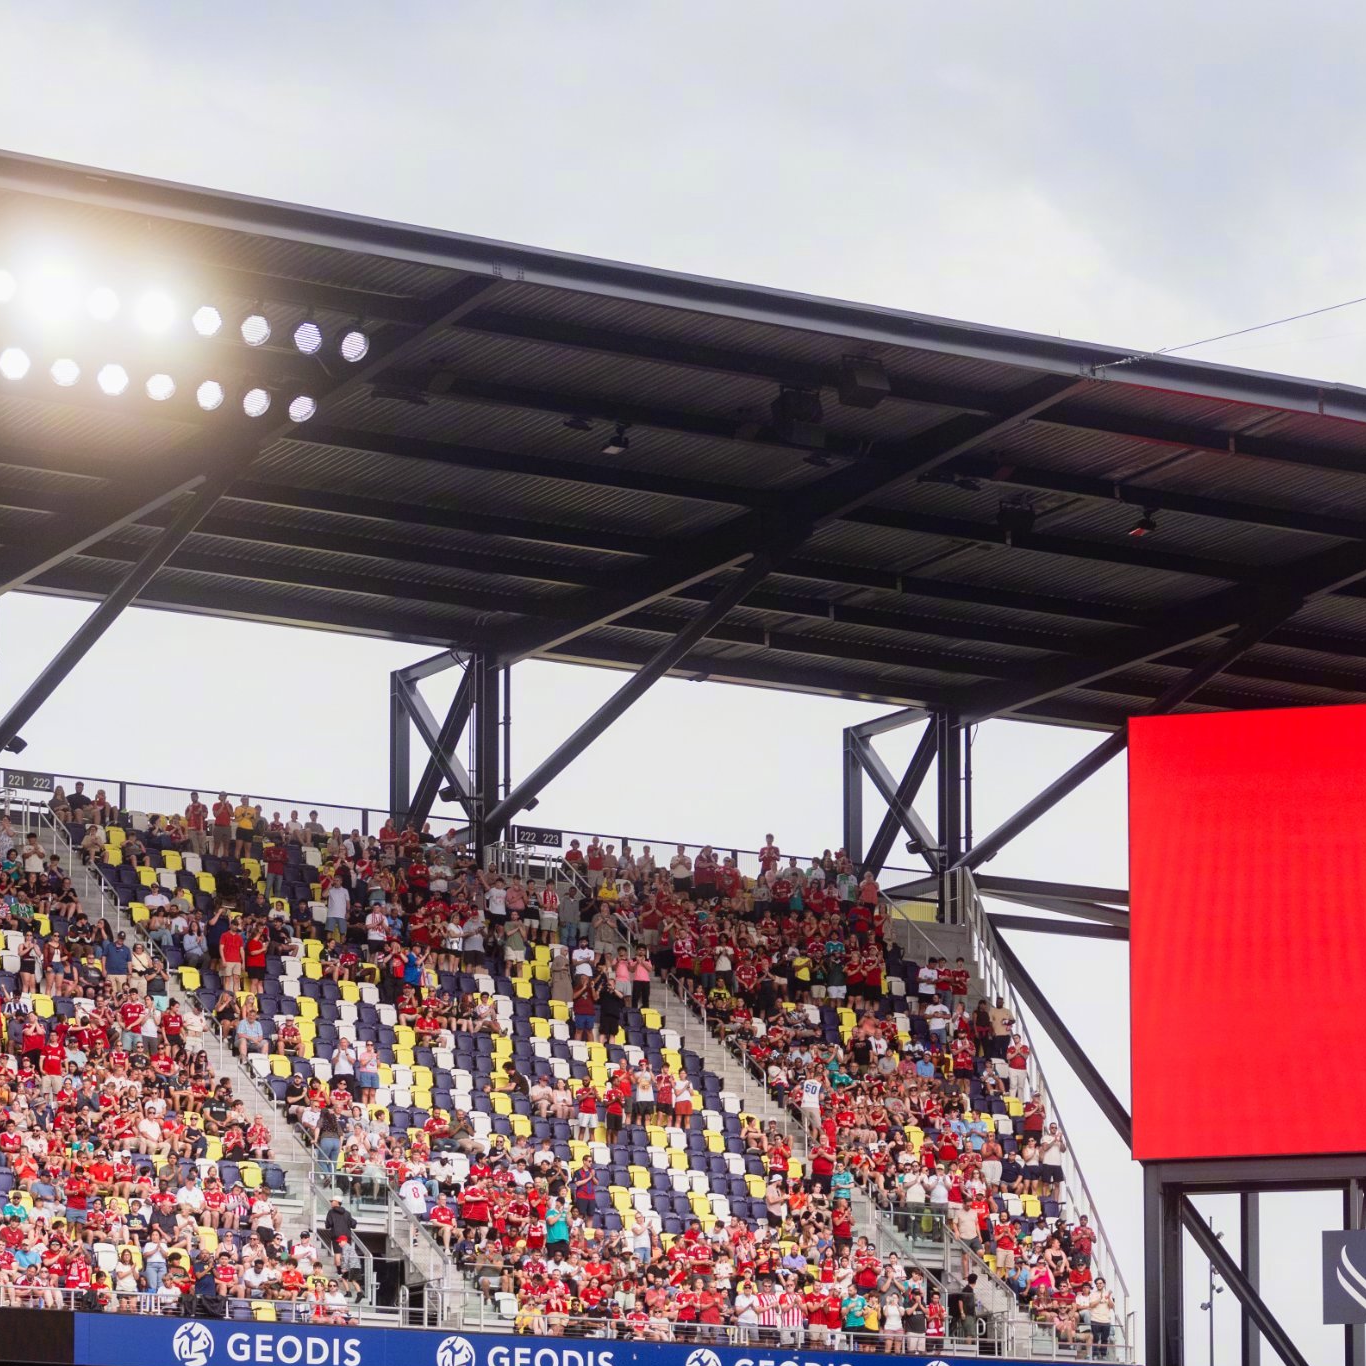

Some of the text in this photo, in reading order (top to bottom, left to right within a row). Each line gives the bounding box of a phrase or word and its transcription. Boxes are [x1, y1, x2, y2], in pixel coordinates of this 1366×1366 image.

[9, 775, 50, 789] 221 222
[520, 831, 558, 845] 222 223
[805, 1084, 817, 1095] 50
[226, 1332, 362, 1366] GEODIS
